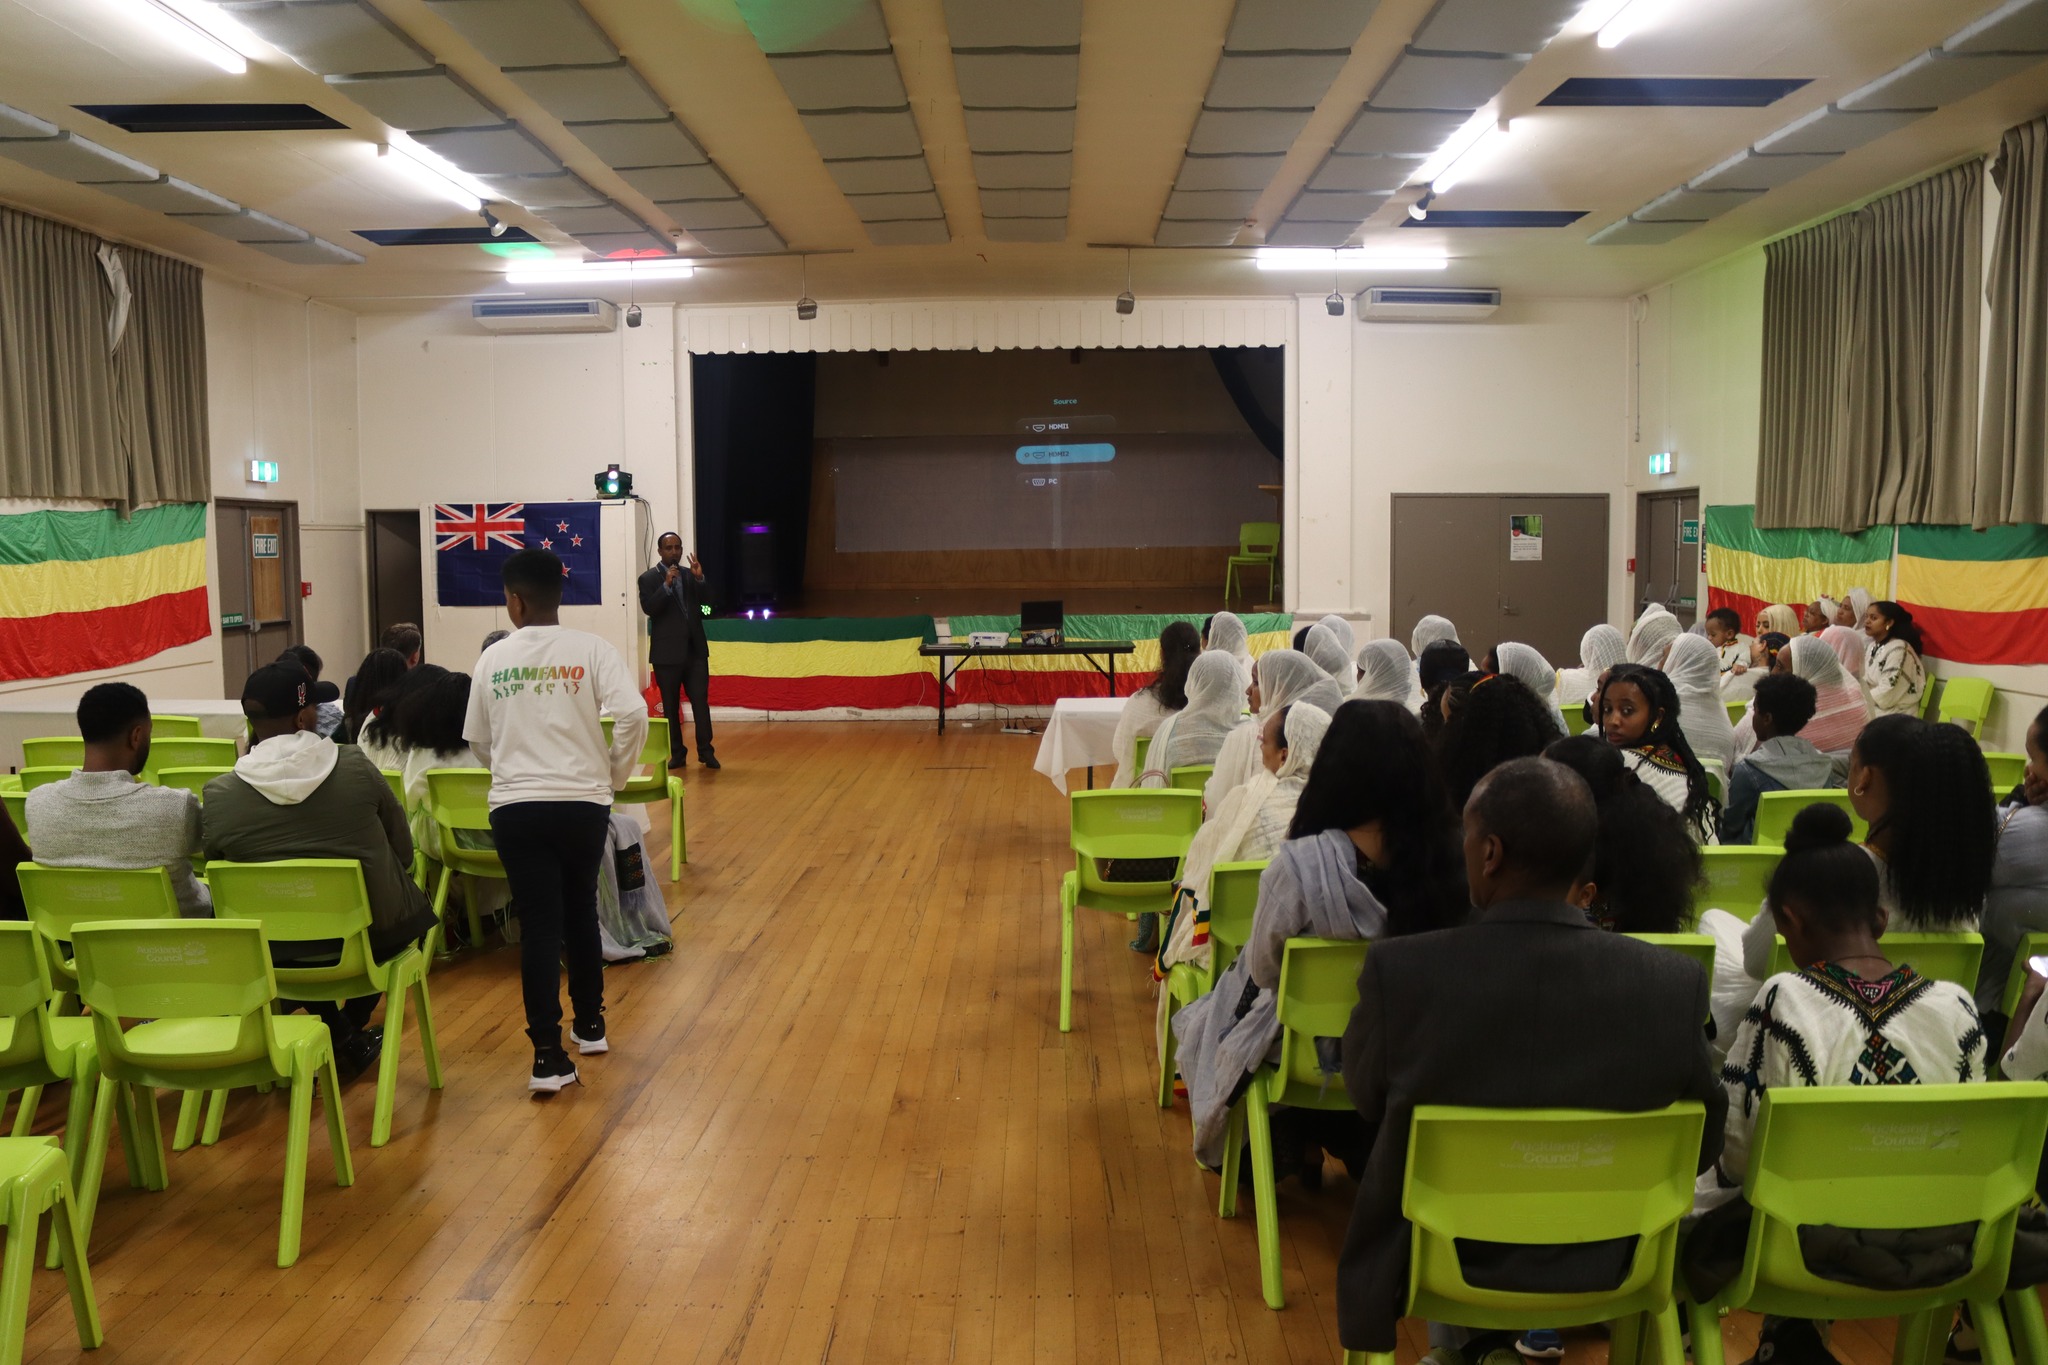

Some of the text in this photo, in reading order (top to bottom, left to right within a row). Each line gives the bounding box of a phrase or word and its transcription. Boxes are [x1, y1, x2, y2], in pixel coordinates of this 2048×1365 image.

[1683, 526, 1692, 537] FIRE
[255, 538, 278, 554] FIRE EXIT
[491, 665, 585, 685] #IAMFANO
[146, 953, 183, 962] Council
[1523, 1151, 1579, 1163] Council
